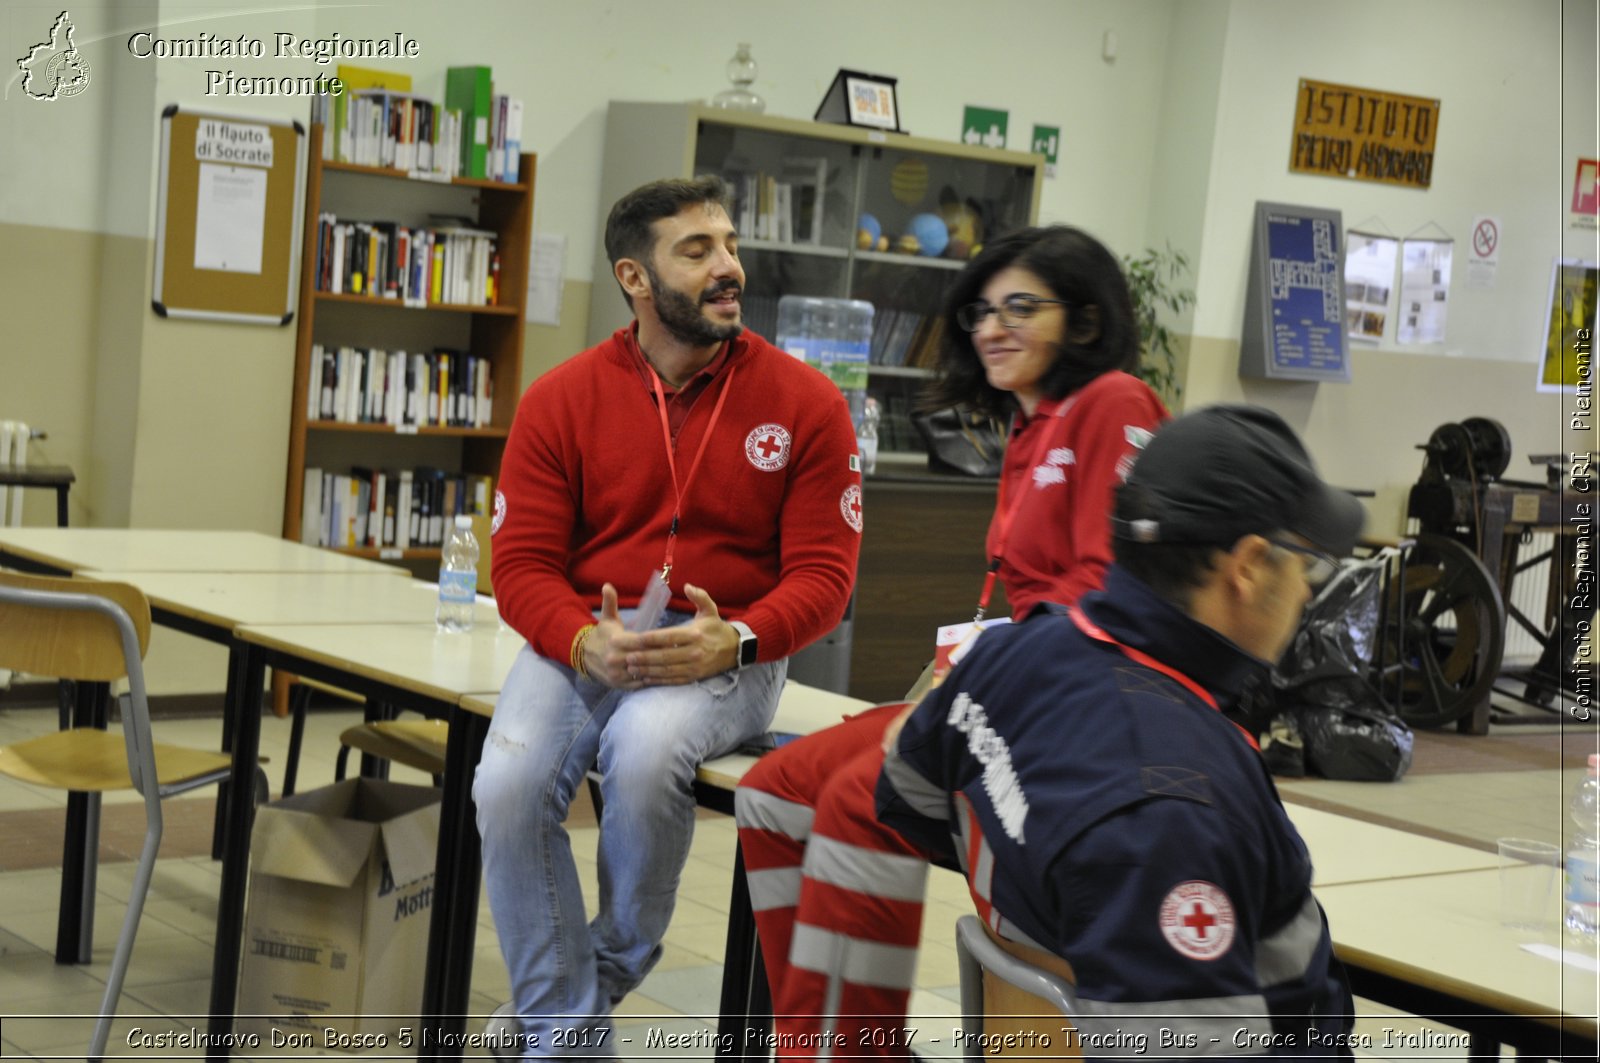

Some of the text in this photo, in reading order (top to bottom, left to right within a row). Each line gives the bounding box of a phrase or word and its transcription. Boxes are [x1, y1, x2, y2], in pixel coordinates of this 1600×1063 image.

[206, 123, 264, 144] Il flauto
[1303, 86, 1431, 146] ISTITUTO
[198, 141, 271, 163] di Socrate
[1294, 132, 1353, 175] PIETRO
[394, 885, 434, 922] Mott
